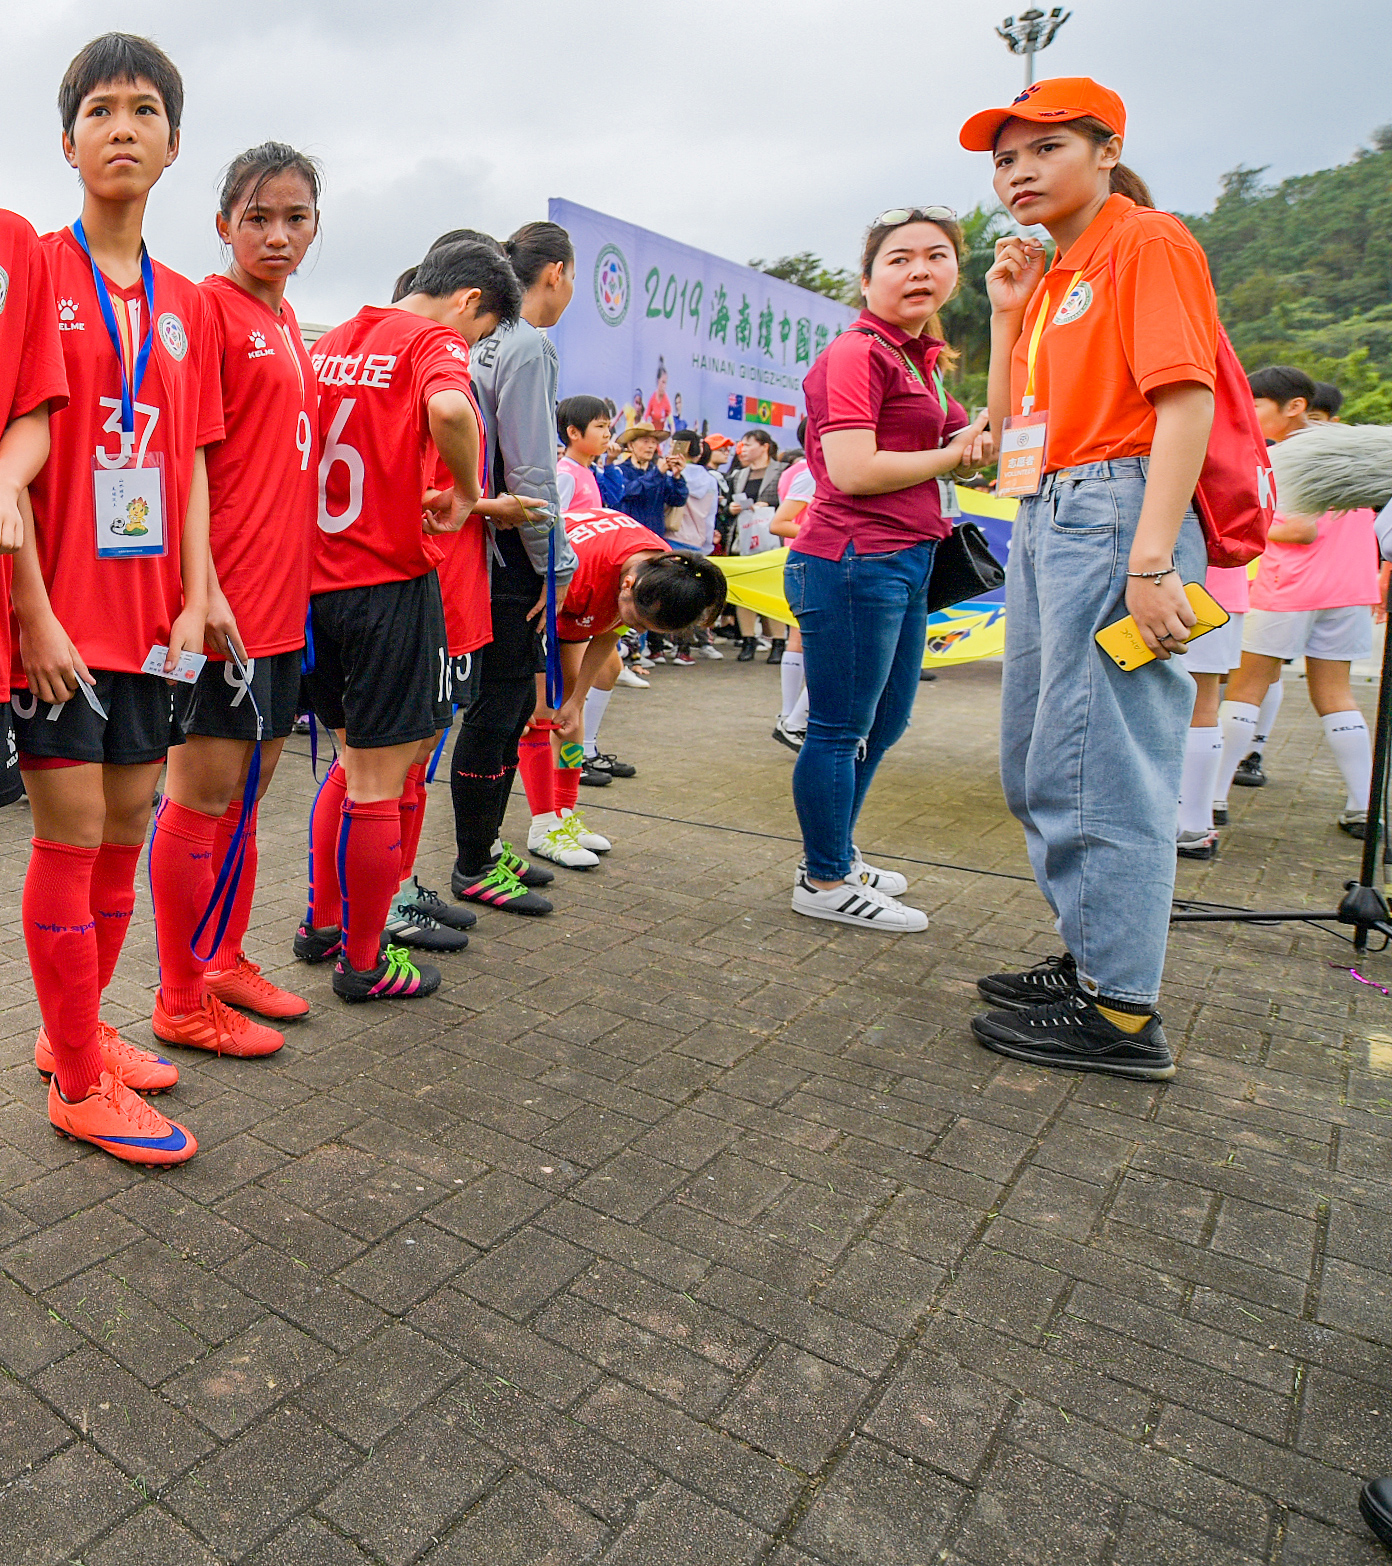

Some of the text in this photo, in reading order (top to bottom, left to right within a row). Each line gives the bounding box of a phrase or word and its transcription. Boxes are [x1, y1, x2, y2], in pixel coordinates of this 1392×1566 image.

[645, 266, 703, 337] 2019
[59, 322, 85, 331] ELME
[248, 348, 276, 359] KELME
[692, 352, 735, 376] HAINAN
[95, 396, 160, 470] 37
[295, 410, 312, 470] 9
[317, 395, 365, 534] 6
[1003, 468, 1036, 478] VOLUNTEER
[223, 658, 255, 707] 9
[34, 921, 67, 933] win
